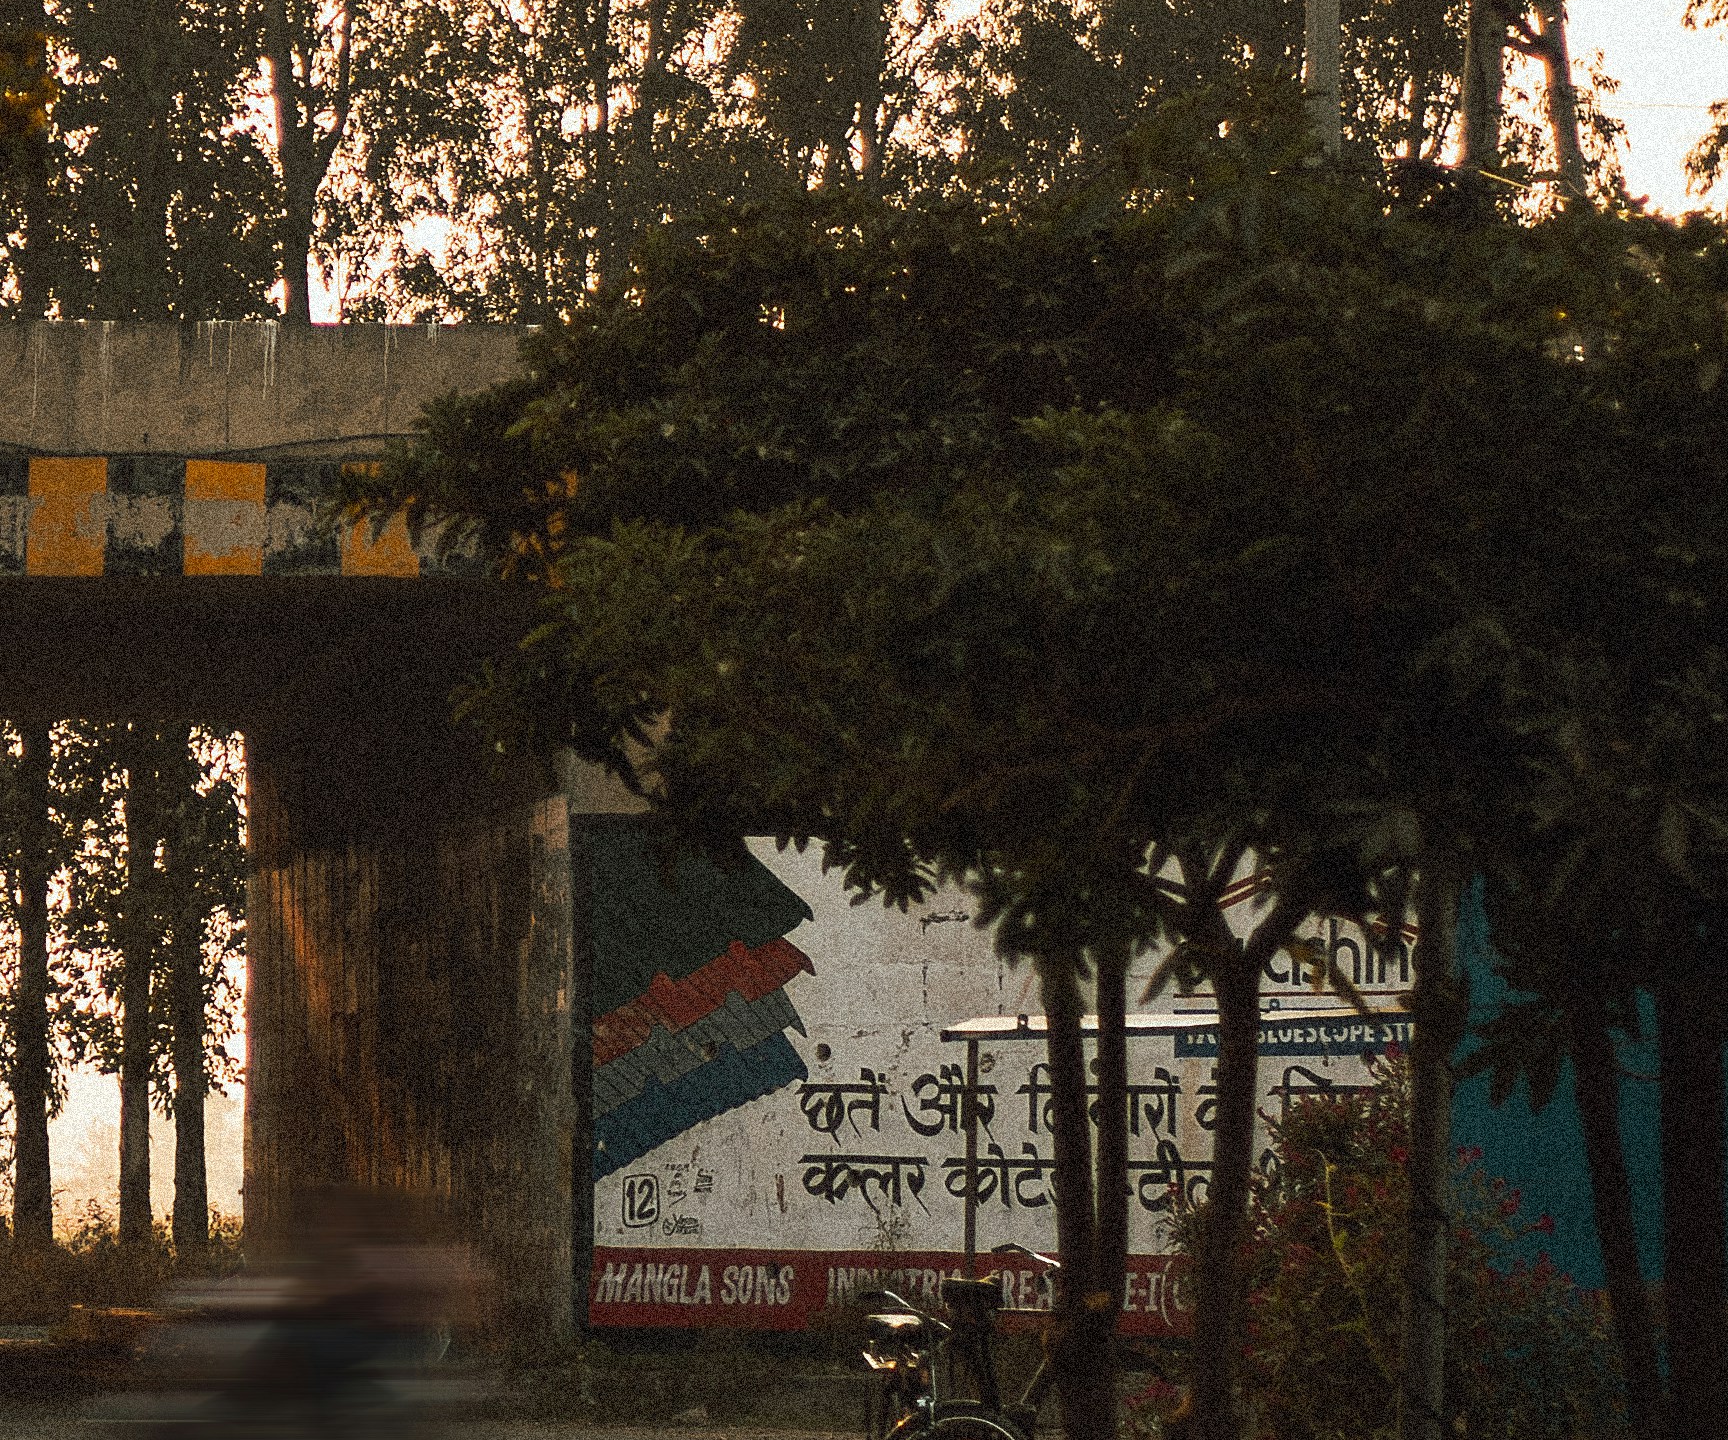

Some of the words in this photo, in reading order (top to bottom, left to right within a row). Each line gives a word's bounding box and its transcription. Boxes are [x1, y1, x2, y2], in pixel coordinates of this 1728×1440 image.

[900, 1063, 998, 1142] और
[627, 1179, 655, 1220] 12
[594, 1262, 713, 1305] MANGLA
[720, 1264, 795, 1306] SONS
[1000, 1269, 1054, 1312] REA
